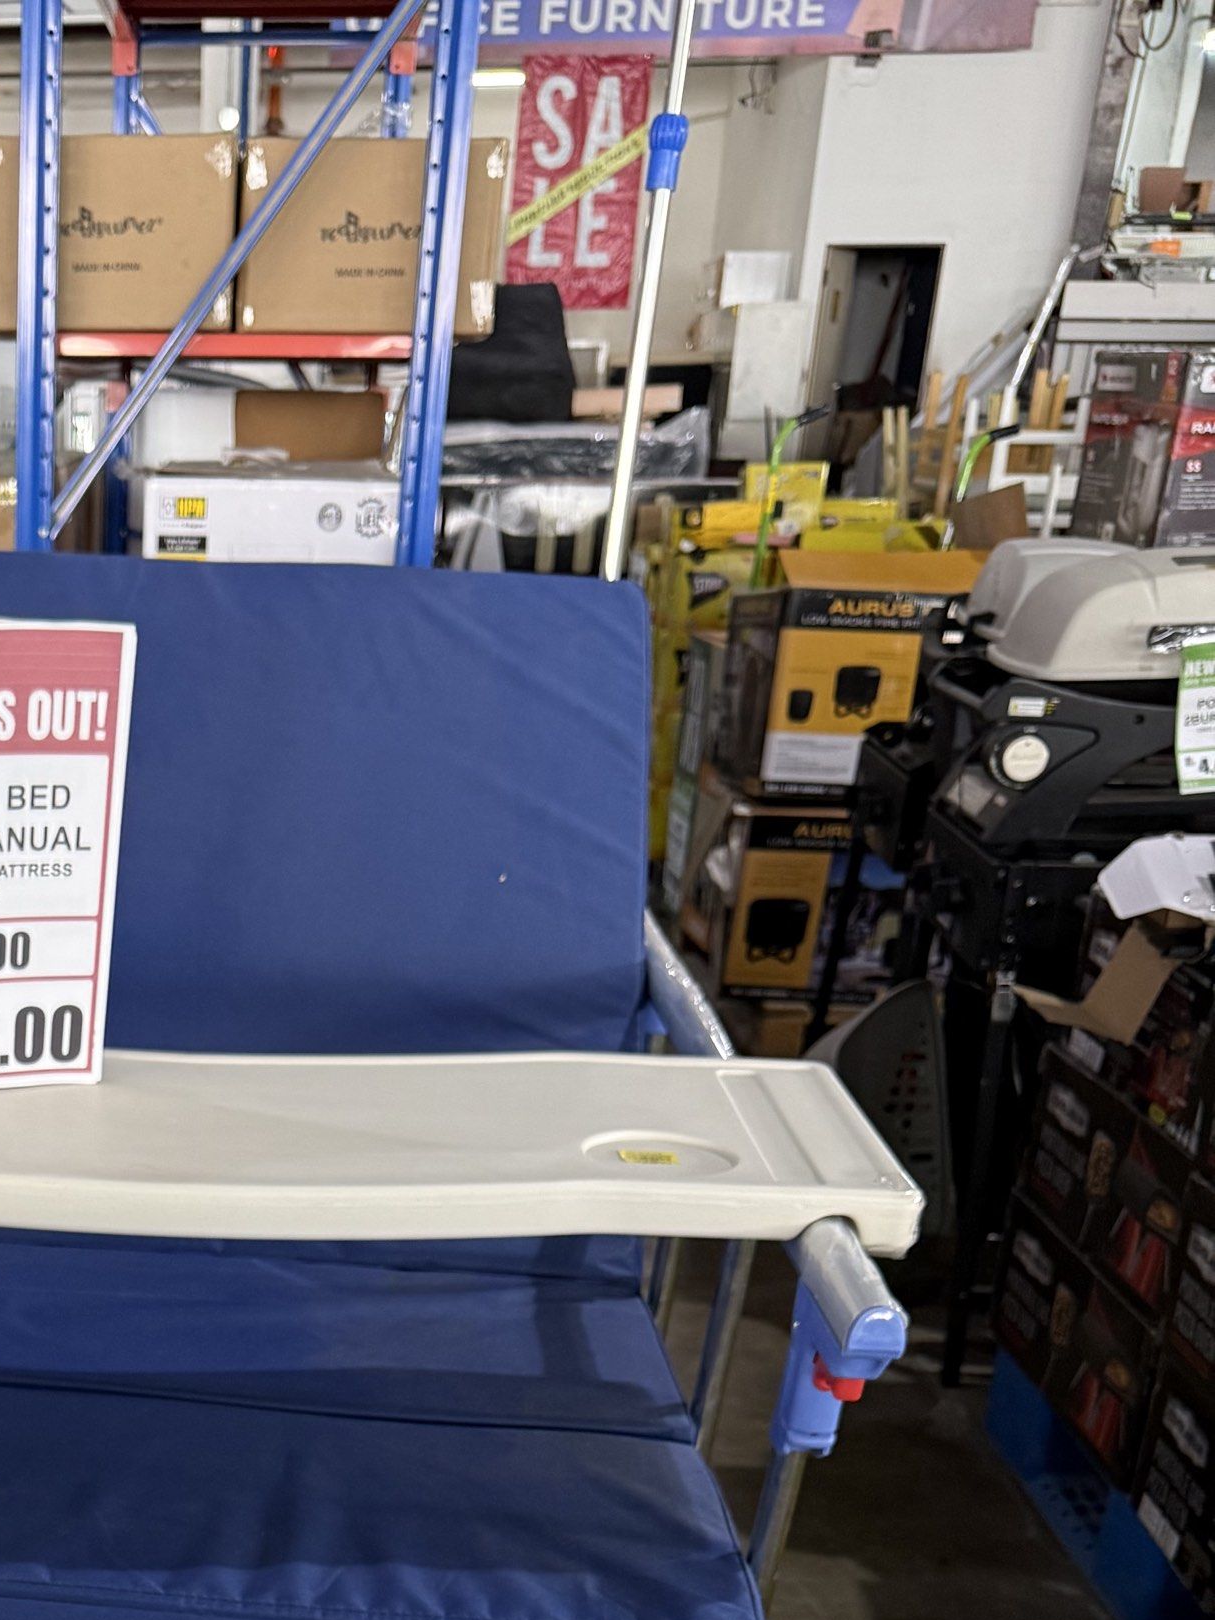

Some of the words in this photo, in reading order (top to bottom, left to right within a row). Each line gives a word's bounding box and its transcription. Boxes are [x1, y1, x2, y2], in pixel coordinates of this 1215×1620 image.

[539, 0, 825, 34] FURNTURE
[828, 599, 916, 618] AURUS
[27, 689, 109, 742] OUT!
[7, 784, 71, 811] BED
